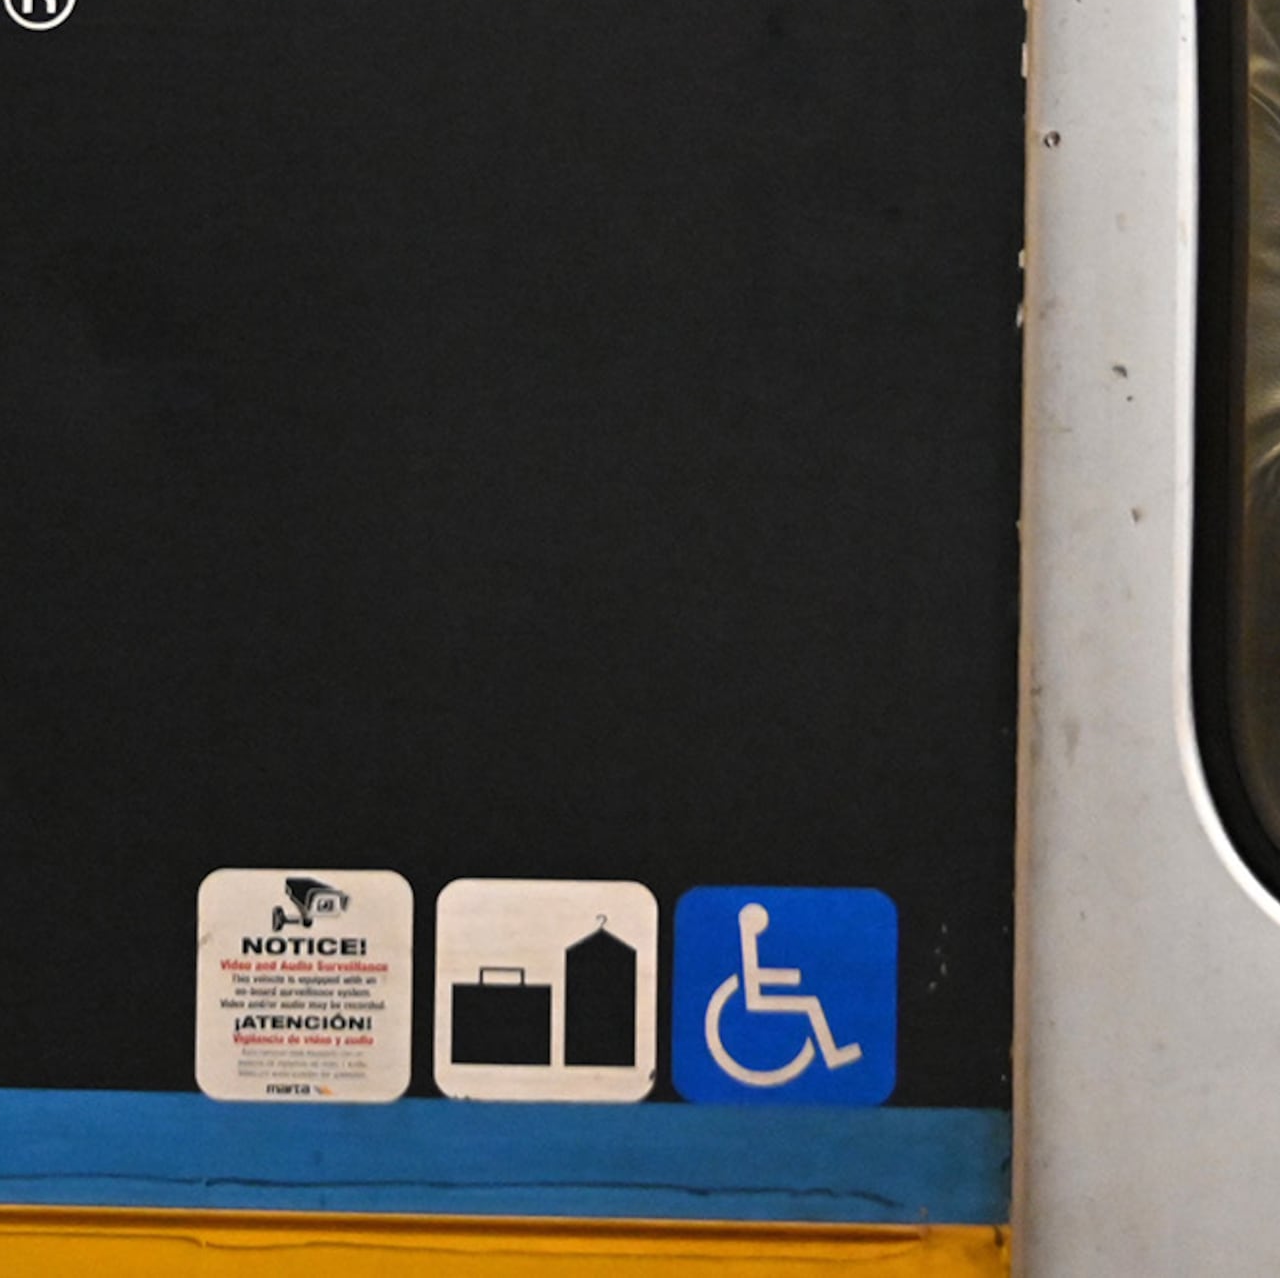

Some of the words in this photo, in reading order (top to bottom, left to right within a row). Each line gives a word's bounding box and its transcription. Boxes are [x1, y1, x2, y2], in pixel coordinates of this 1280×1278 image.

[241, 937, 367, 956] NOTICE!
[220, 960, 251, 971] Video
[255, 961, 276, 971] and
[280, 961, 313, 971] Audio
[317, 961, 388, 972] Surveillance
[235, 1013, 372, 1032] ¡ATENCIÓN!
[266, 1083, 311, 1095] marta
